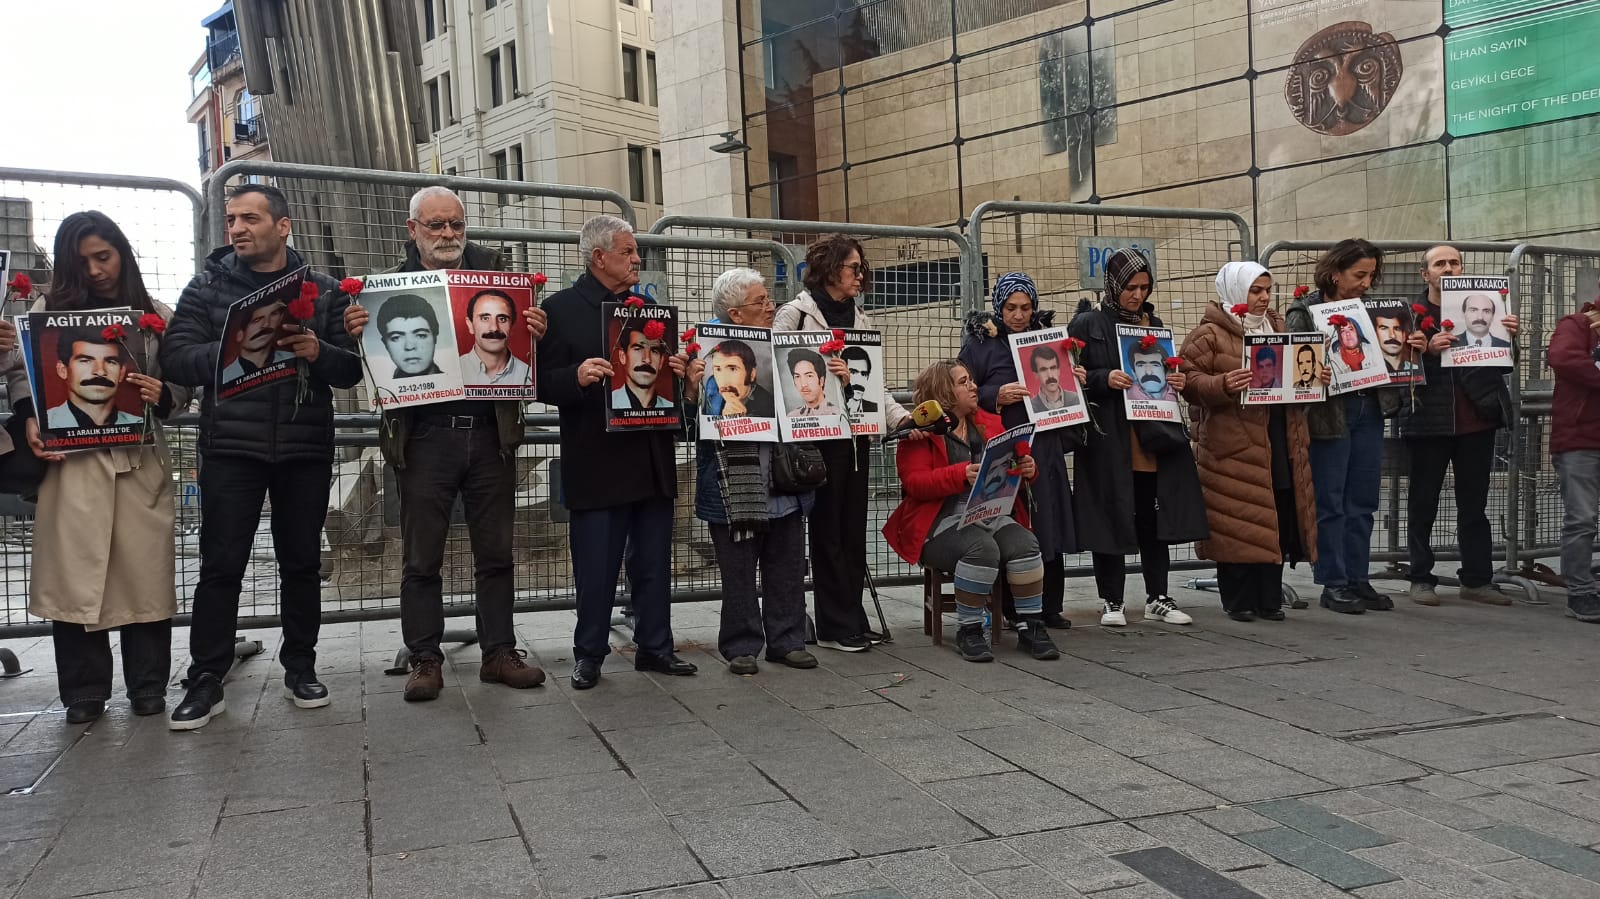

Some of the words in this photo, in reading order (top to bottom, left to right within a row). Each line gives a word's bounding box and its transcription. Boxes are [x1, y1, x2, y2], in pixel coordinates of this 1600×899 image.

[1450, 45, 1487, 61] İLHAN
[1490, 36, 1527, 53] SAYIN
[1450, 71, 1497, 90] GEYİKLİ
[1500, 65, 1536, 81] GECE
[1451, 111, 1476, 123] THE
[1478, 103, 1518, 119] NIGHT
[1521, 100, 1539, 111] OF
[1542, 94, 1569, 107] THE
[1571, 87, 1600, 102] DEE
[411, 274, 442, 285] KAYA
[447, 274, 489, 285] KENAN
[1443, 279, 1472, 289] RIDVAN
[1365, 300, 1378, 309] GİT
[1380, 299, 1403, 308] AKİPA
[639, 306, 671, 319] AKİPA
[45, 313, 83, 328] AGİT
[85, 312, 133, 327] AKİPA
[702, 326, 728, 337] CEMİL
[729, 328, 768, 340] KIRBAYIR
[862, 332, 881, 342] CİHAN
[1016, 334, 1039, 346] FEHMİ
[1039, 331, 1064, 342] TOSUN
[398, 382, 436, 394] 23-12-1980
[421, 387, 464, 400] KAYBEDİLDİ
[493, 385, 534, 397] KAYBEDİLDİ
[76, 428, 101, 436] ARALIK
[102, 426, 131, 434] 1991'DE
[720, 421, 771, 438] KAYBEDİLDİ
[791, 424, 842, 439] KAYBEDİLDİ
[46, 435, 100, 448] GÖZALTINDA
